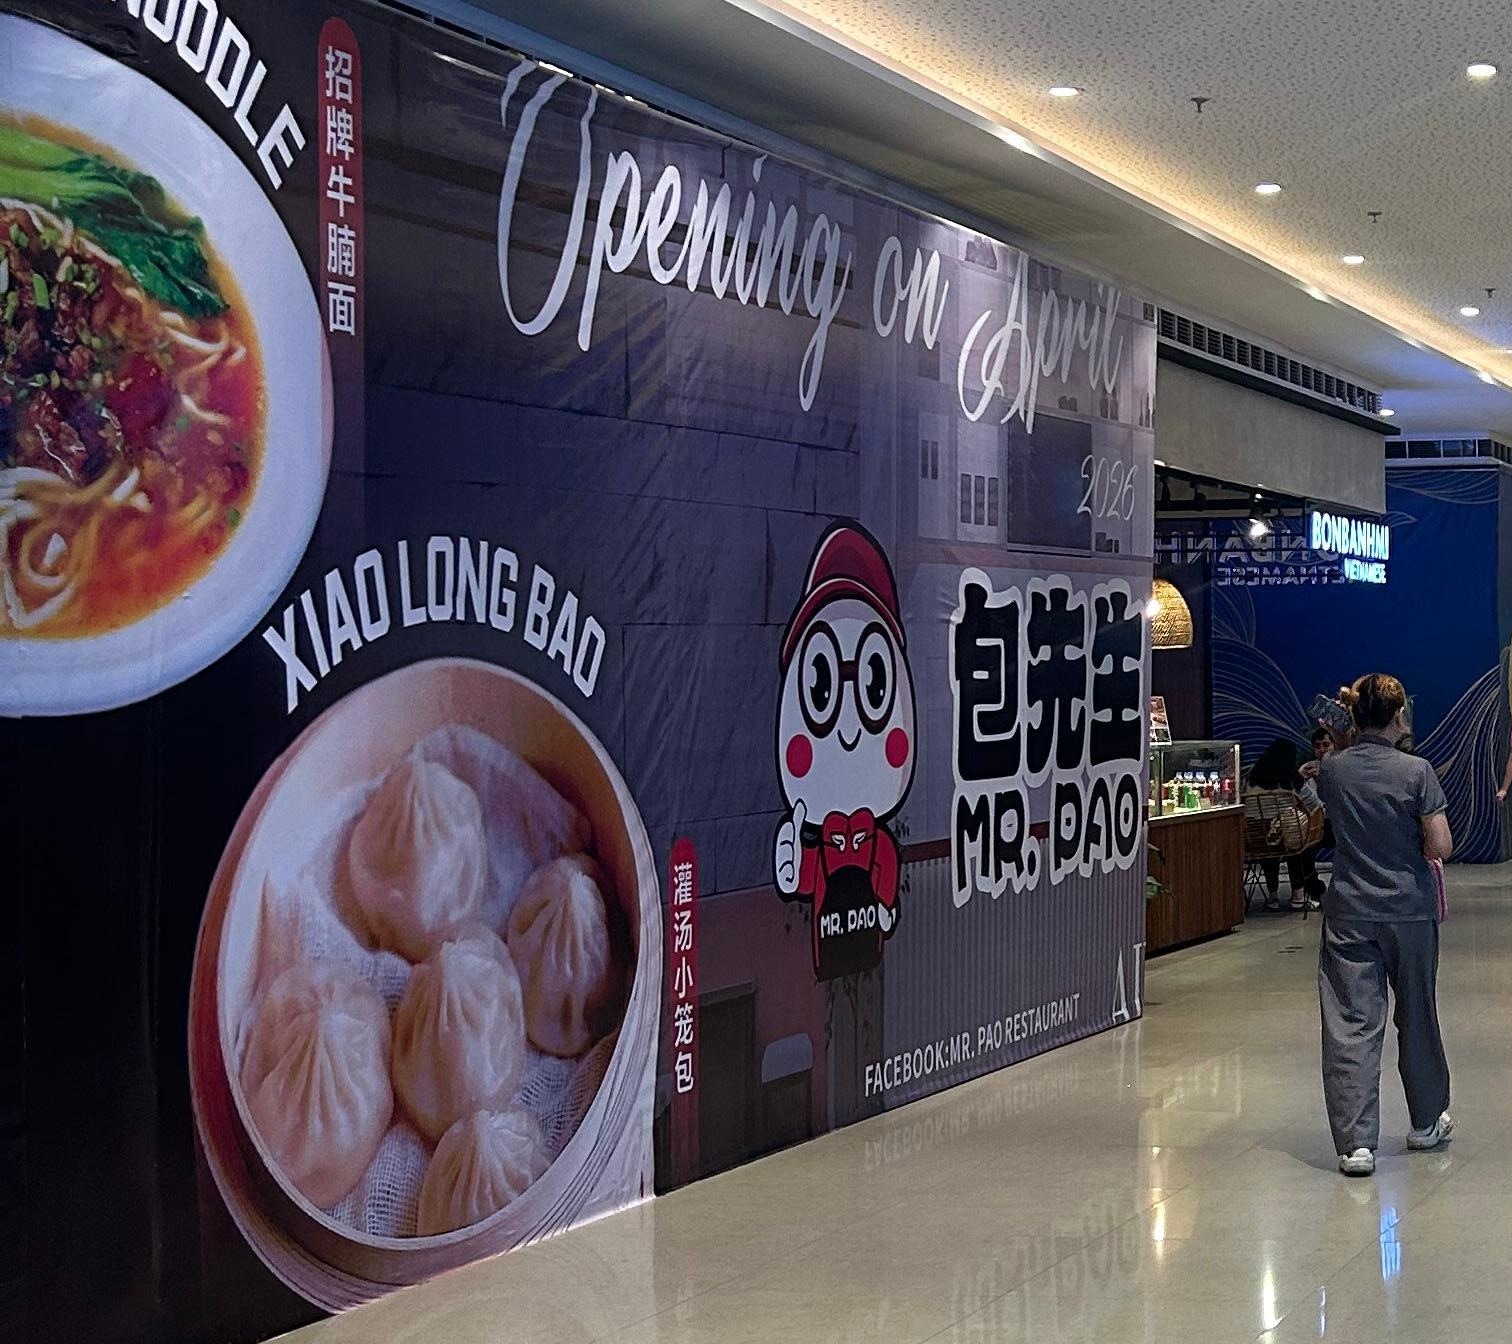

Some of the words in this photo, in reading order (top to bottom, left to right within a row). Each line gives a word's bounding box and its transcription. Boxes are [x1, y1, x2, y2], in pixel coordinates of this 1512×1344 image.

[324, 45, 356, 337] 招牌牛腩面
[498, 59, 847, 412] Opening
[871, 232, 950, 351] on
[956, 252, 1124, 436] April
[1076, 454, 1139, 522] 2026
[261, 548, 391, 716] XIAO
[397, 535, 519, 633] LONG
[522, 563, 607, 698] BAO
[951, 574, 1143, 784] 包先生
[820, 912, 844, 939] MR.
[847, 904, 876, 933] PAO
[953, 786, 1039, 900] MR.
[1052, 770, 1142, 880] PAO
[673, 862, 695, 1094] 灌汤小笼包
[977, 1019, 1003, 1055] PAO
[1004, 992, 1081, 1045] RESTAURANT
